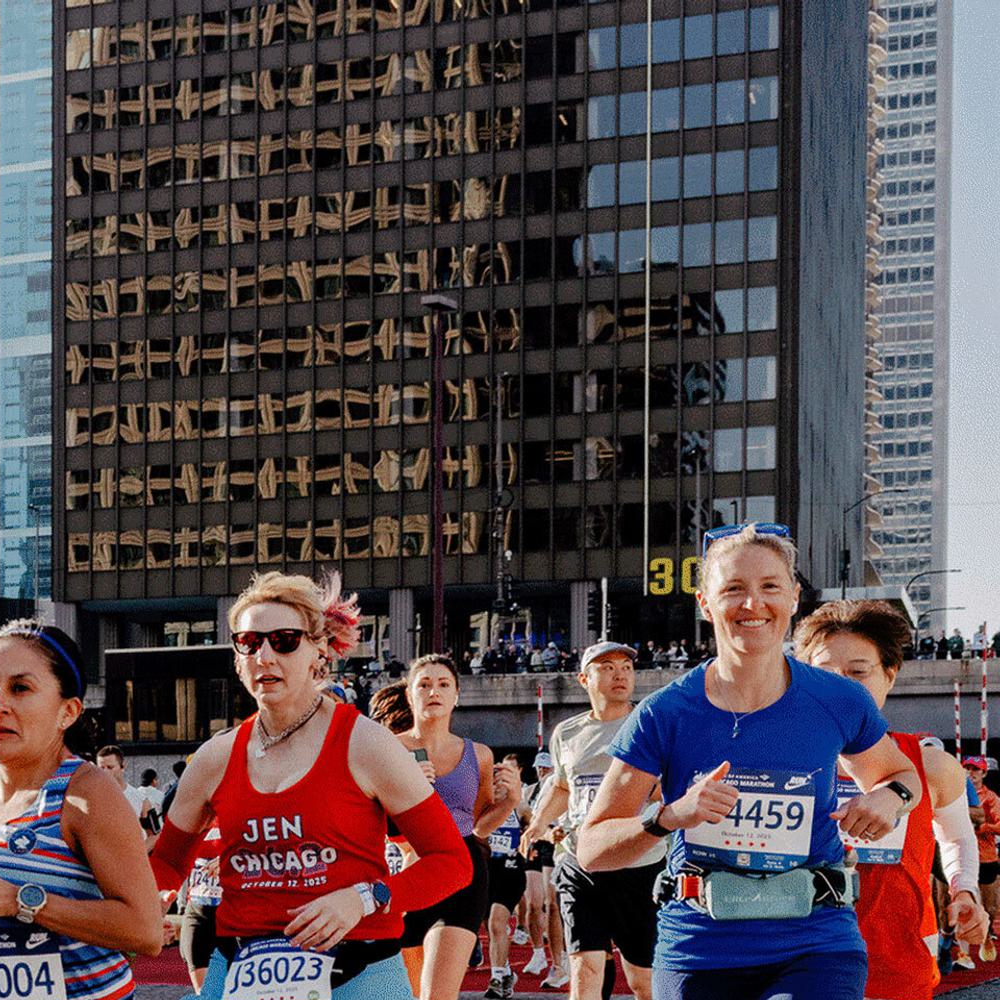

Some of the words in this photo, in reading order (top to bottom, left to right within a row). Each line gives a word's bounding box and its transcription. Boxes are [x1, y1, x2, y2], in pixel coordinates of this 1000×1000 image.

[243, 815, 302, 843] JEN
[725, 798, 805, 831] 4459
[230, 847, 337, 873] CHICAGO
[229, 956, 323, 994] J36023
